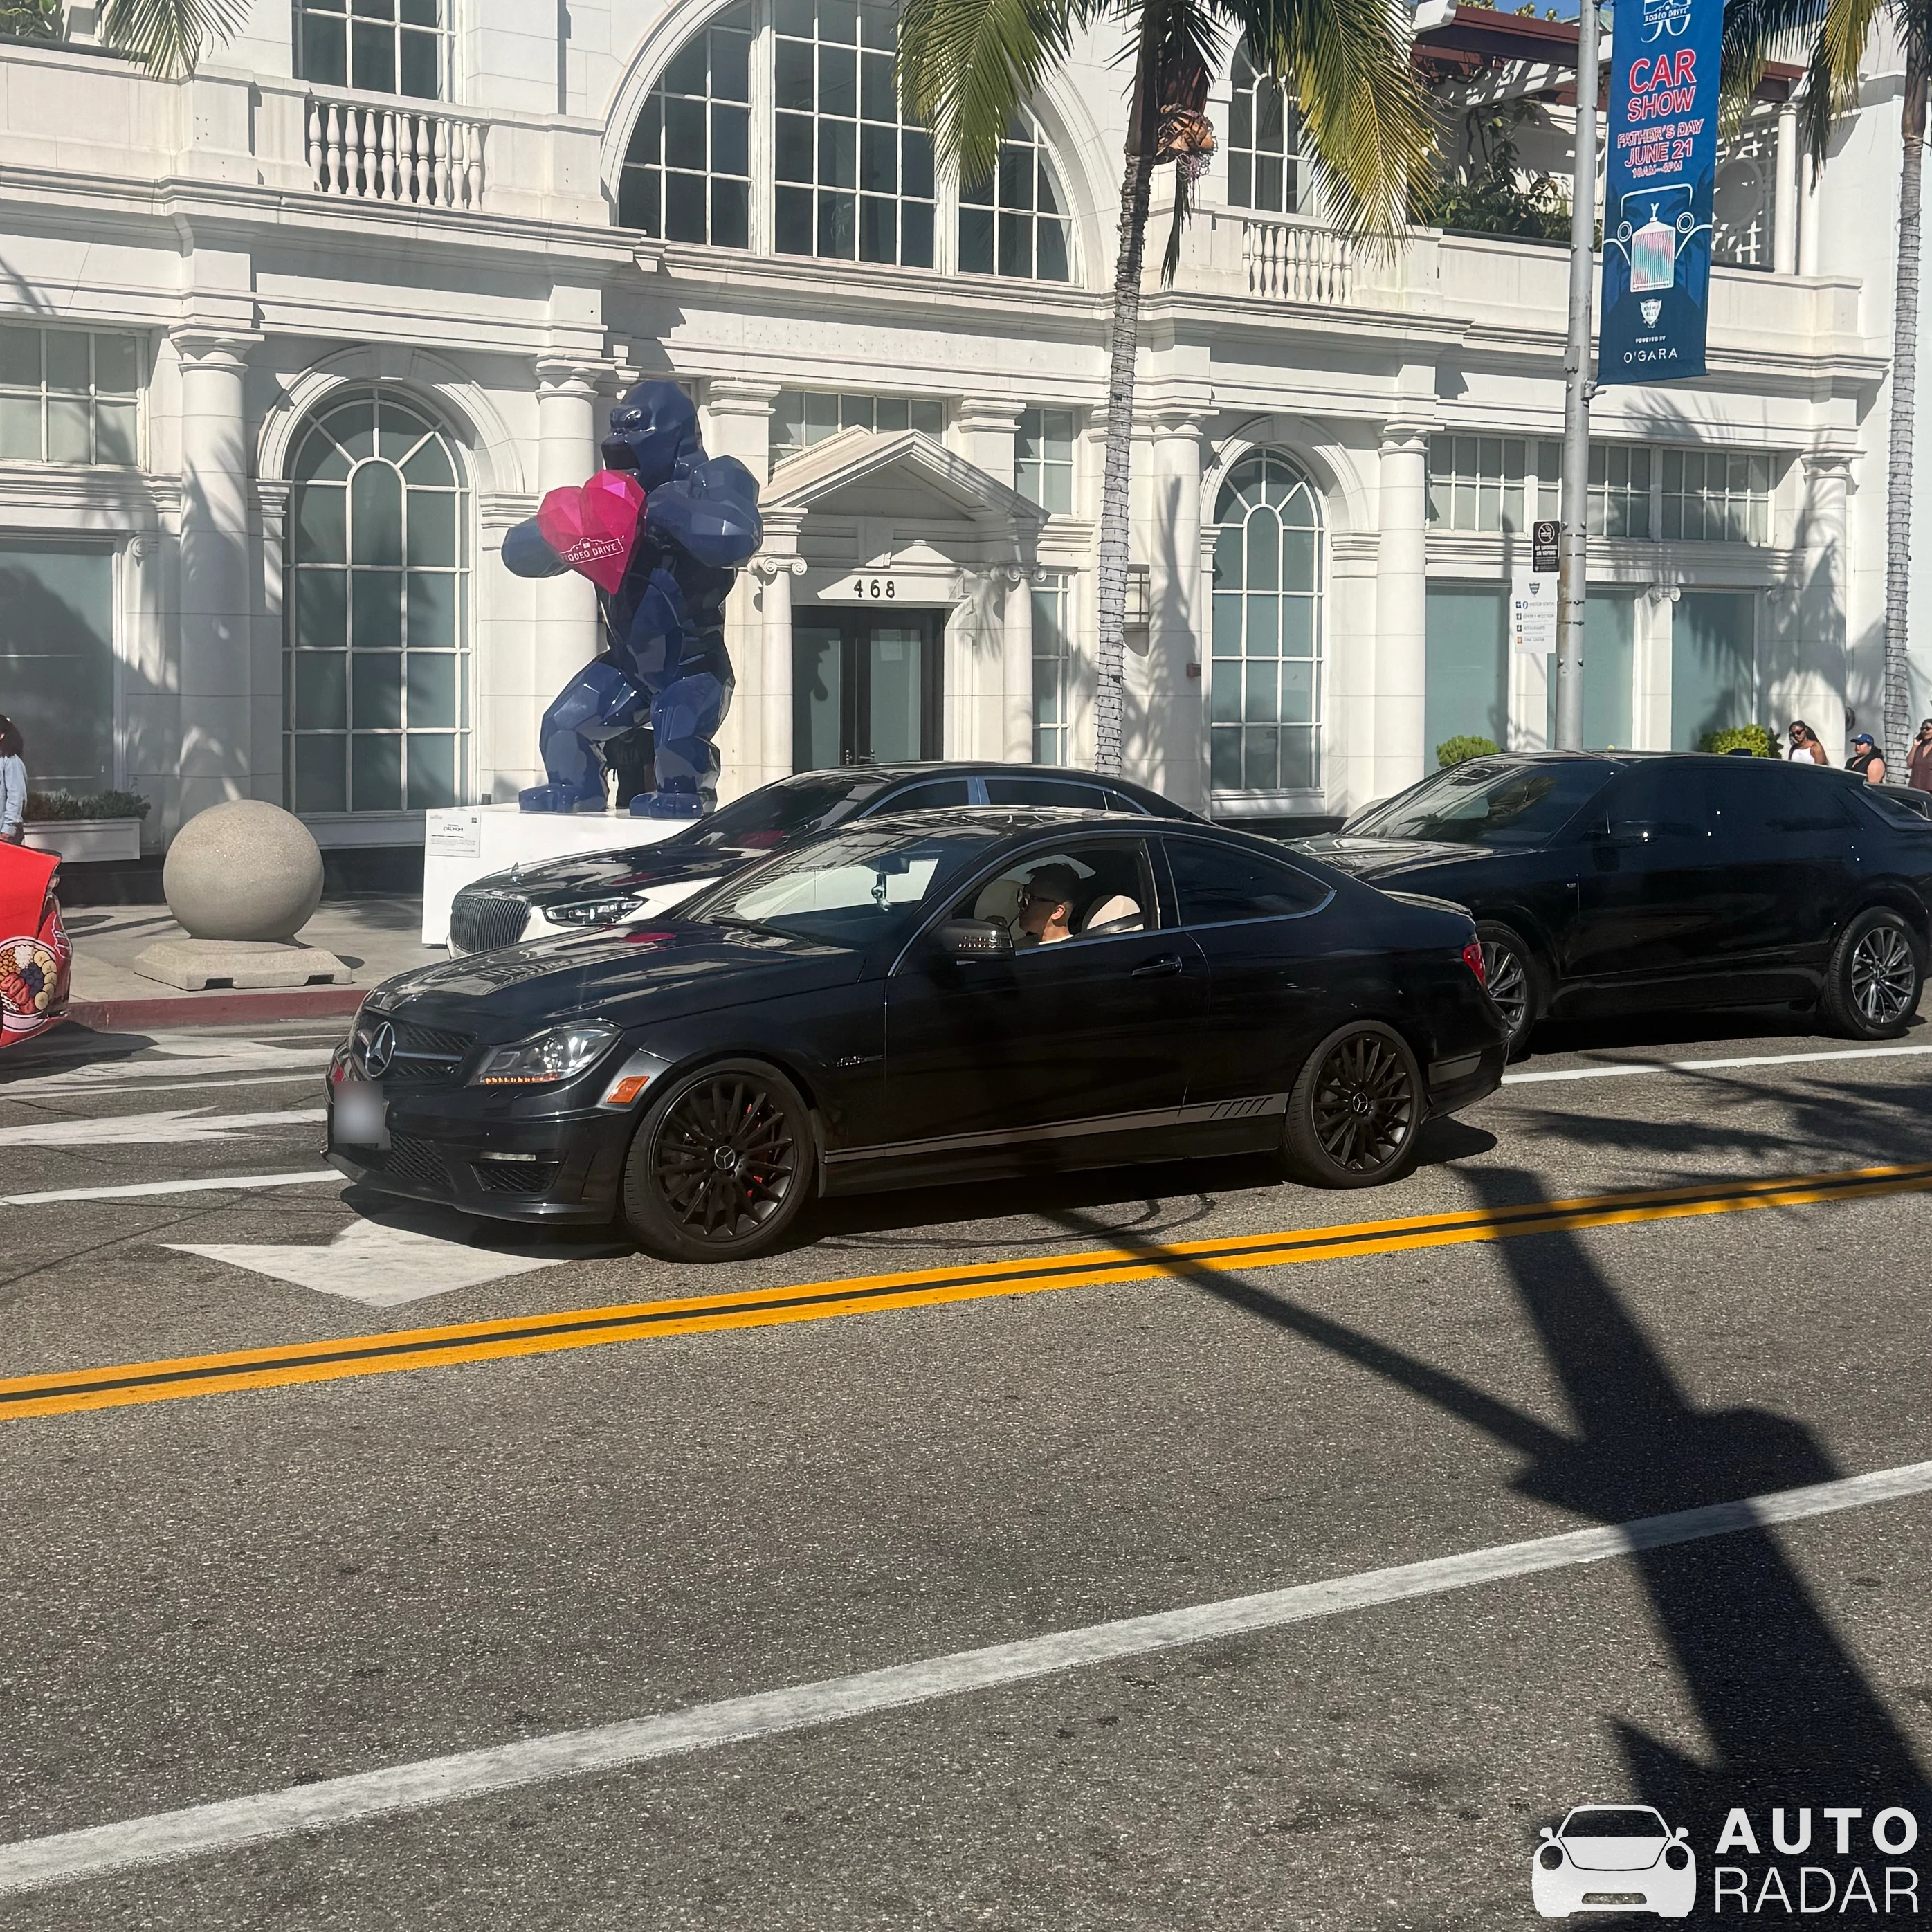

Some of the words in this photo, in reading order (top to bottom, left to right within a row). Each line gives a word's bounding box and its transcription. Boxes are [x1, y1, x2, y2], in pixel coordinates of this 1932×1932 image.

[1629, 48, 1697, 95] CAR
[1627, 86, 1697, 122] SHOW
[1616, 123, 1675, 149] FATHER'S
[1677, 118, 1705, 137] DAY
[1624, 140, 1670, 167] JUNE
[1671, 138, 1693, 160] 21
[1623, 347, 1678, 364] O'GARA
[592, 543, 617, 556] DRIVE
[853, 578, 895, 599] 468
